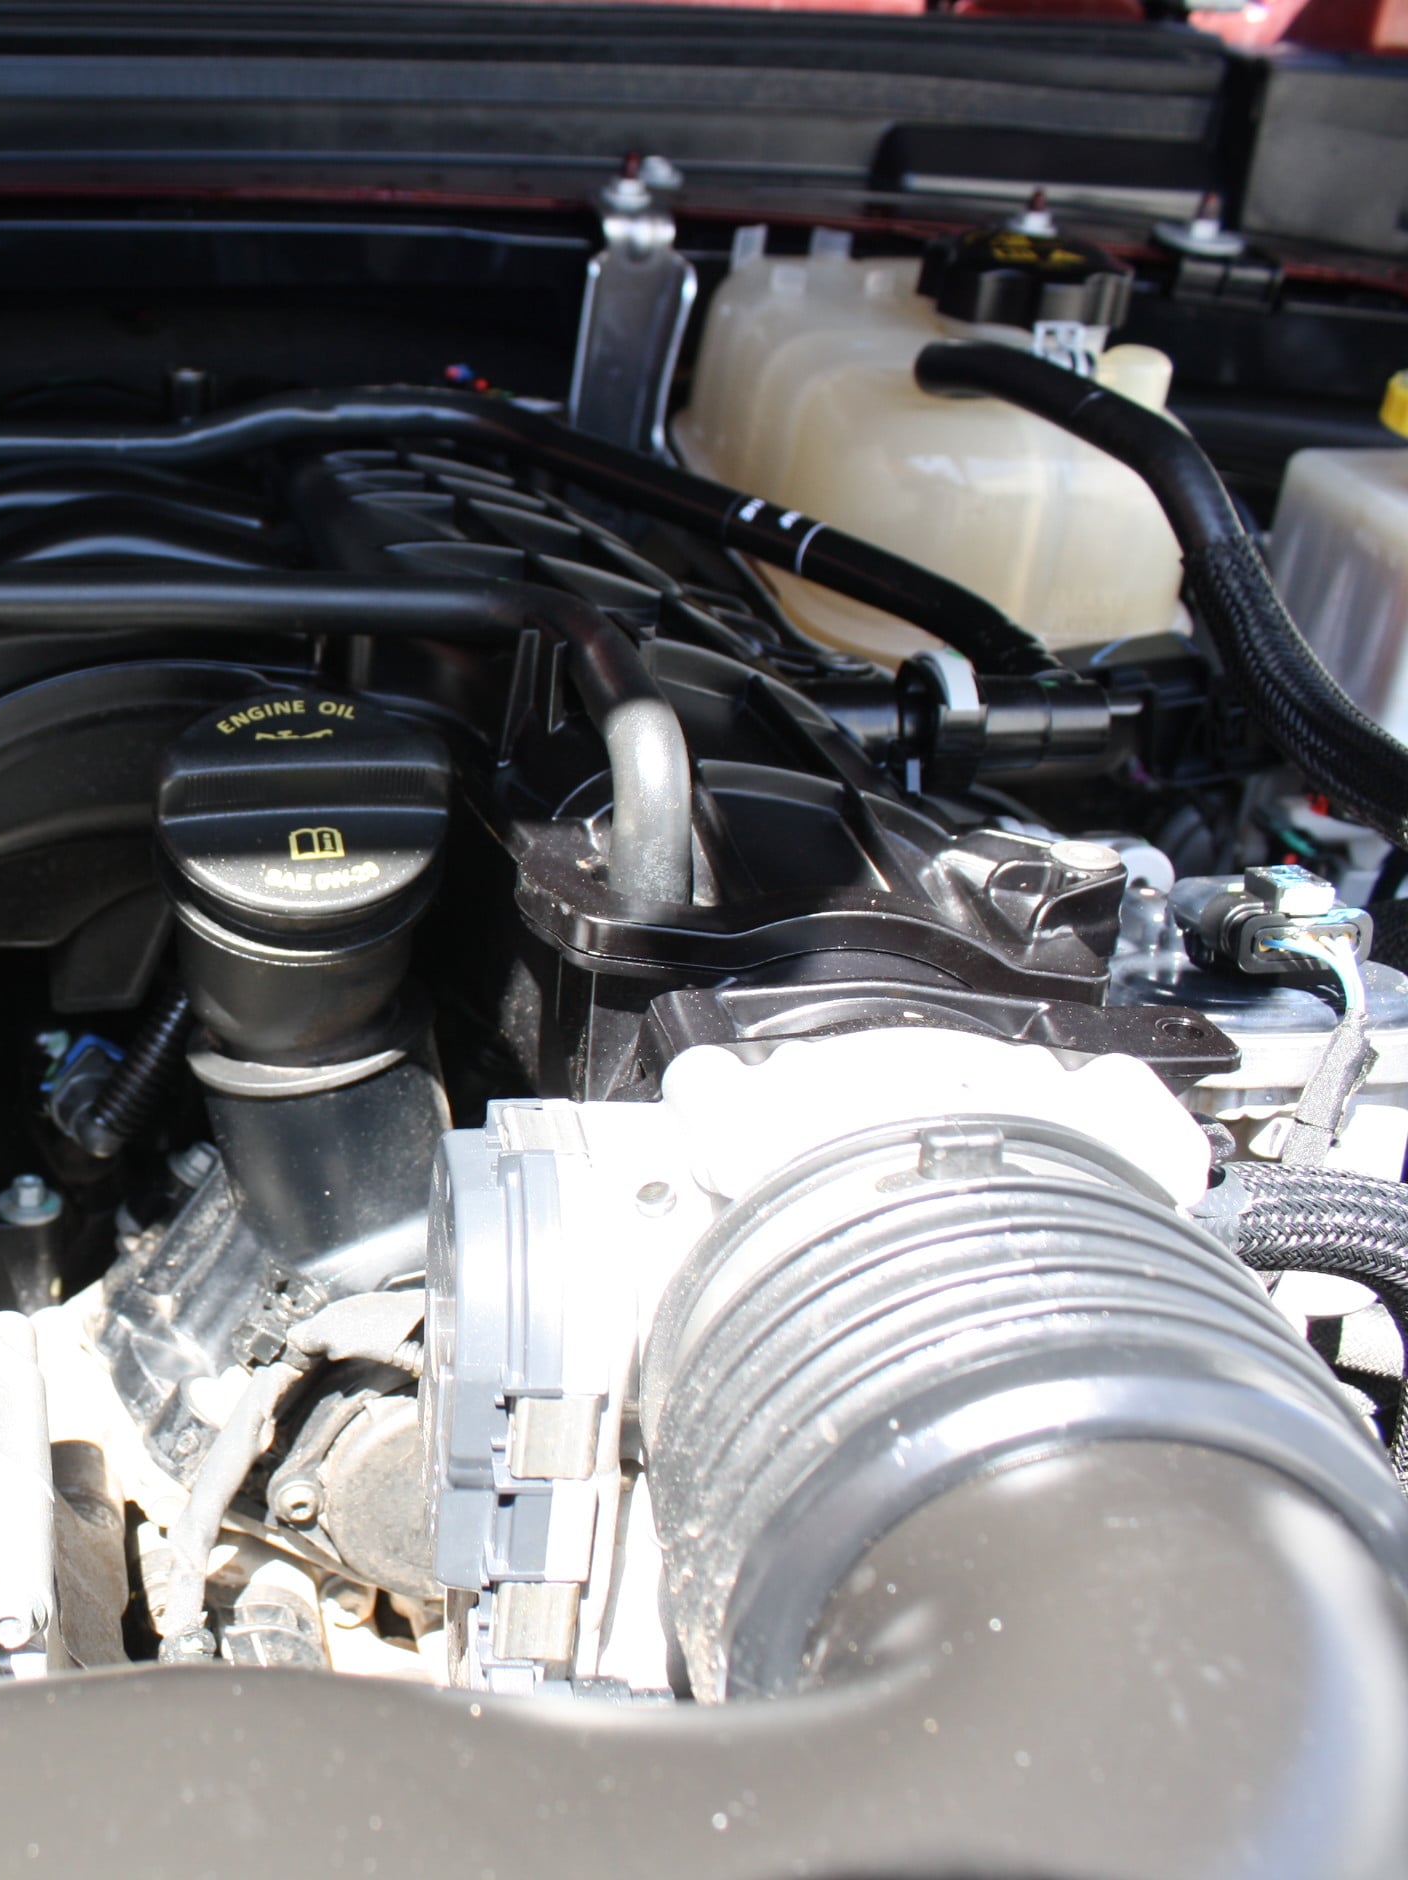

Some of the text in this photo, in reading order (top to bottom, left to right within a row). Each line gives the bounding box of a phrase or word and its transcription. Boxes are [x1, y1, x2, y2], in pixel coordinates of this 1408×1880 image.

[216, 699, 356, 735] ENGINE OIL
[264, 868, 313, 891] SAE
